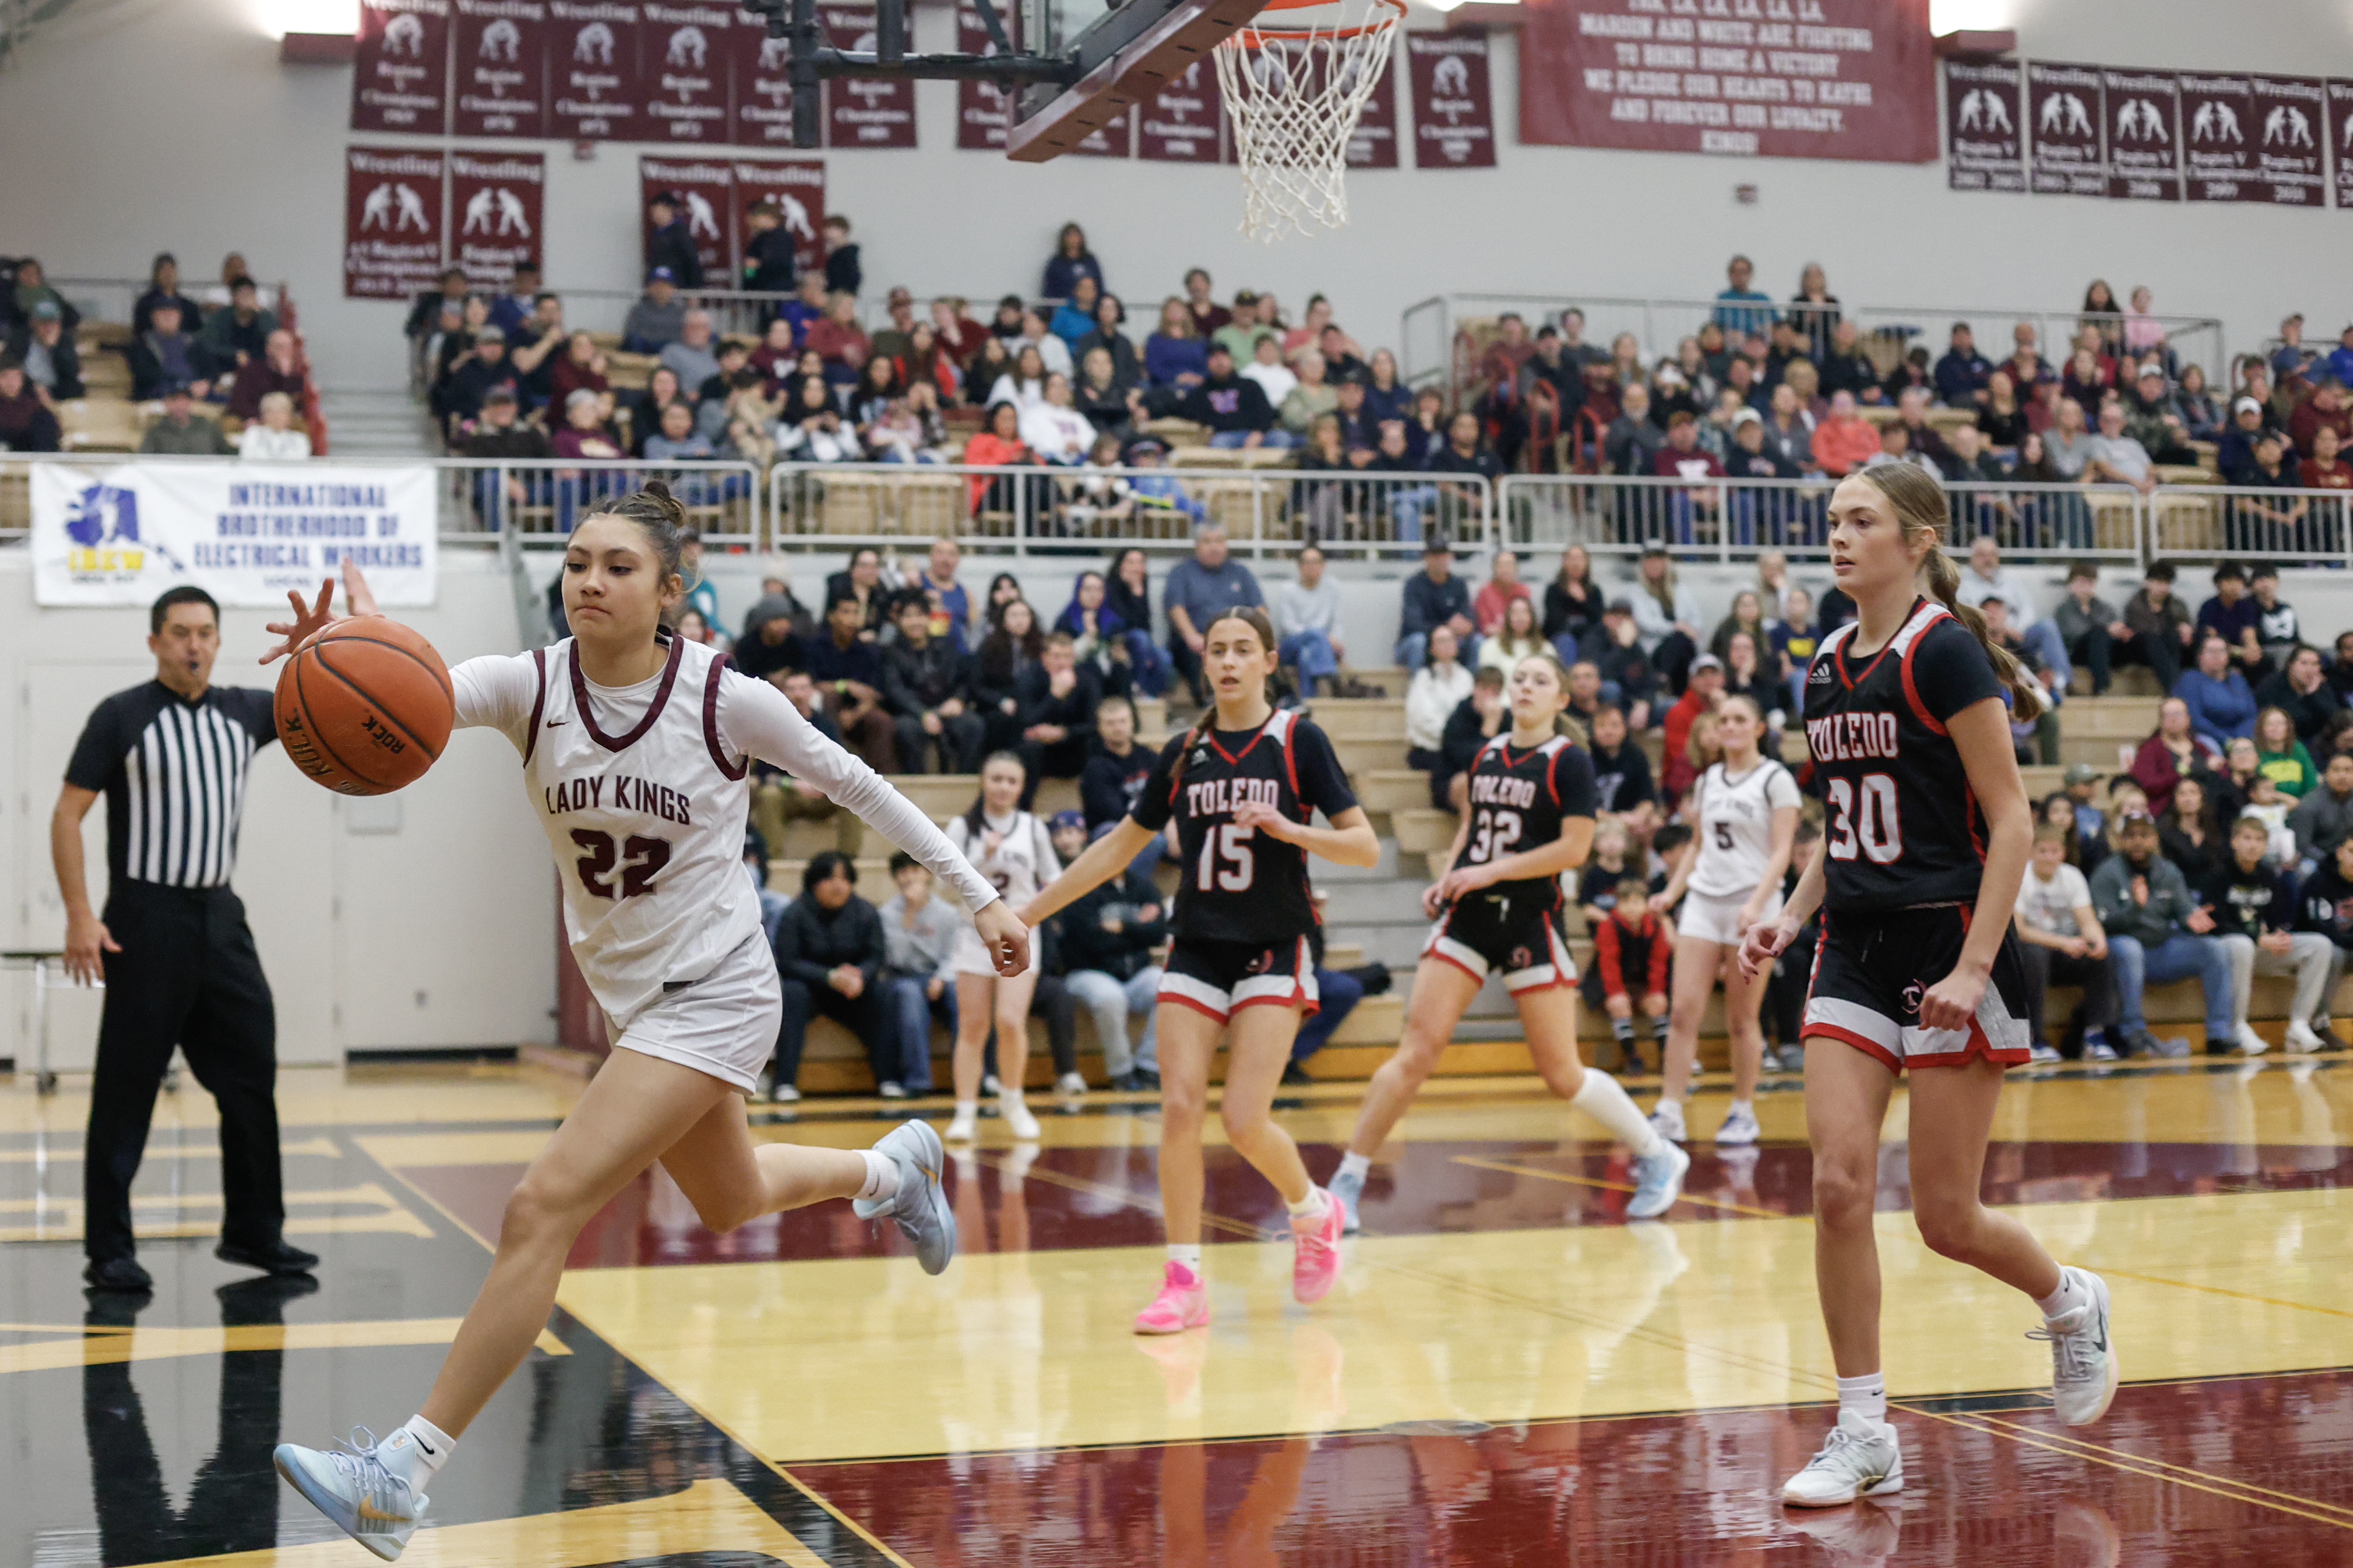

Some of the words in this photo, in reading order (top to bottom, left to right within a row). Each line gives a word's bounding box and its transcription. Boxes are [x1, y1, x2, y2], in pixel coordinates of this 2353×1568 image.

[1657, 17, 1694, 41] AND
[1751, 51, 1766, 70] A
[1611, 100, 1648, 122] AND
[230, 482, 387, 508] INTERNATIONAL
[217, 514, 366, 537] BROTHERHOOD
[378, 514, 398, 536] OF
[68, 548, 144, 571] IBEW
[194, 544, 310, 568] ELECTRICAL
[362, 714, 406, 754] ROCK
[1807, 712, 1898, 762] TOLEDO
[545, 775, 604, 814] LADY
[616, 775, 690, 825] KINGS
[1187, 778, 1279, 817] TOLEDO
[1471, 775, 1536, 809] TOLEDO
[1714, 821, 1735, 850] 5
[1827, 773, 1903, 864] 30
[1469, 809, 1522, 863] 32
[569, 828, 672, 901] 22
[1198, 823, 1254, 892] 15
